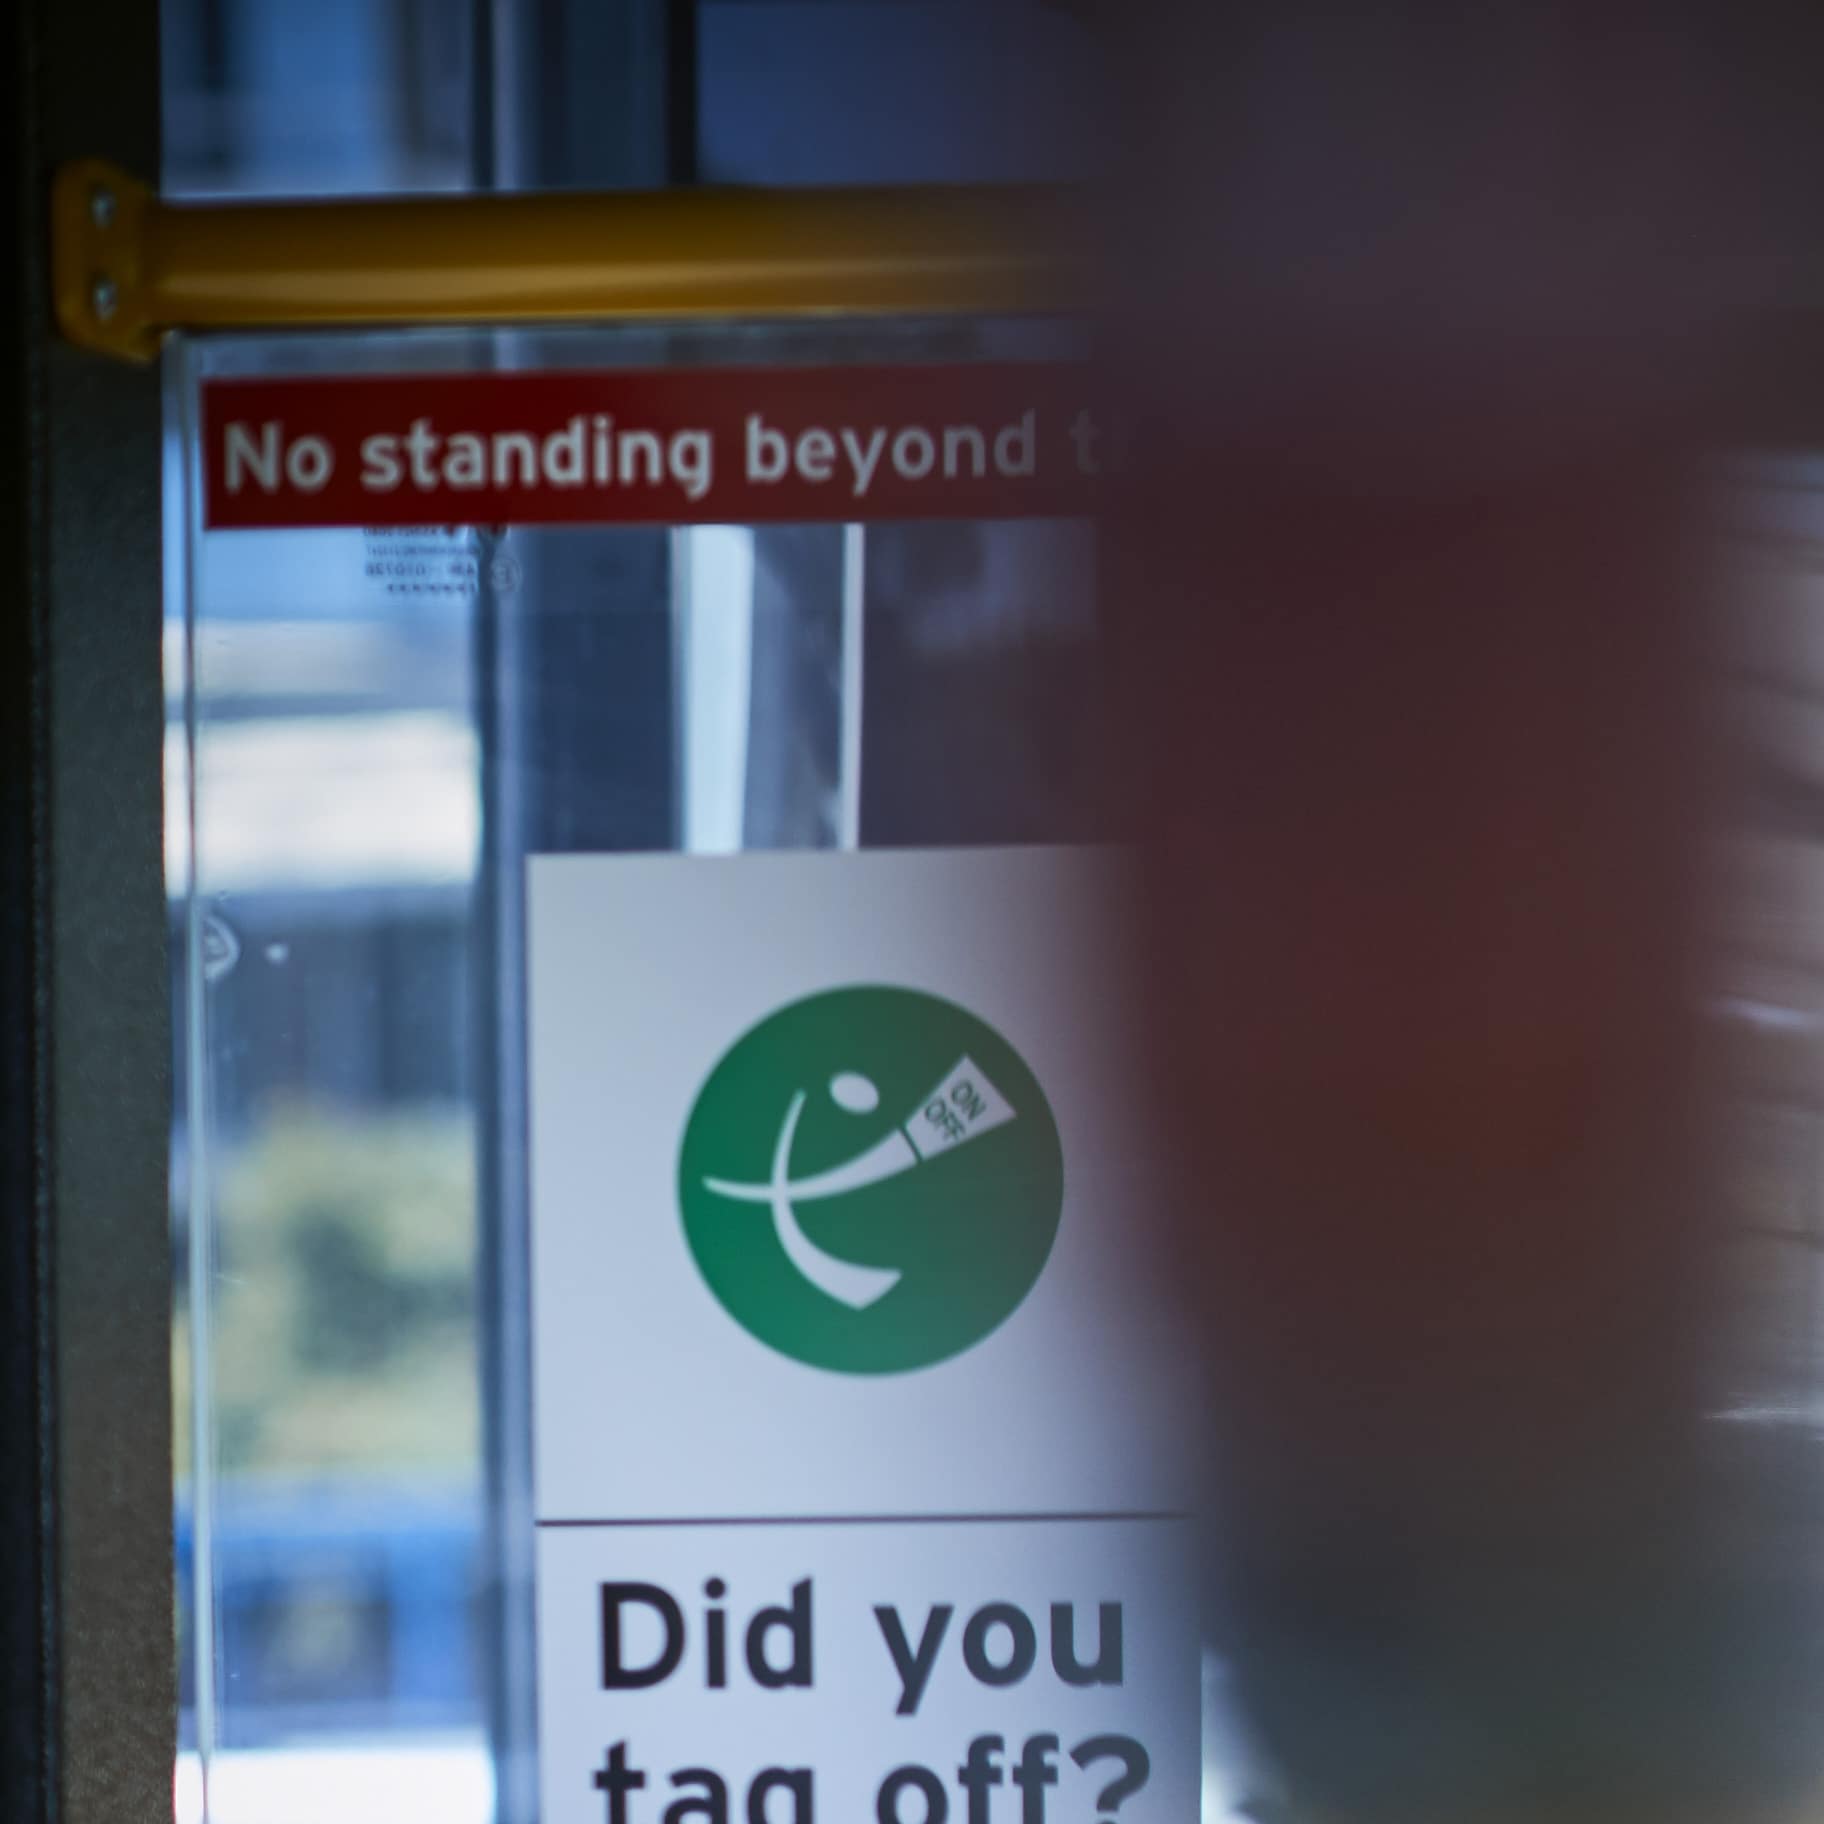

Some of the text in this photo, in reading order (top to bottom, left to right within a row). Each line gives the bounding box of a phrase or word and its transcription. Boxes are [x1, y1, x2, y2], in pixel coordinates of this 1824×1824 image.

[223, 420, 332, 493] No
[359, 414, 713, 500] standing
[744, 409, 1036, 495] beyond
[925, 1098, 966, 1142] OFF
[951, 1080, 987, 1121] ON
[600, 1577, 1125, 1717] Did you
